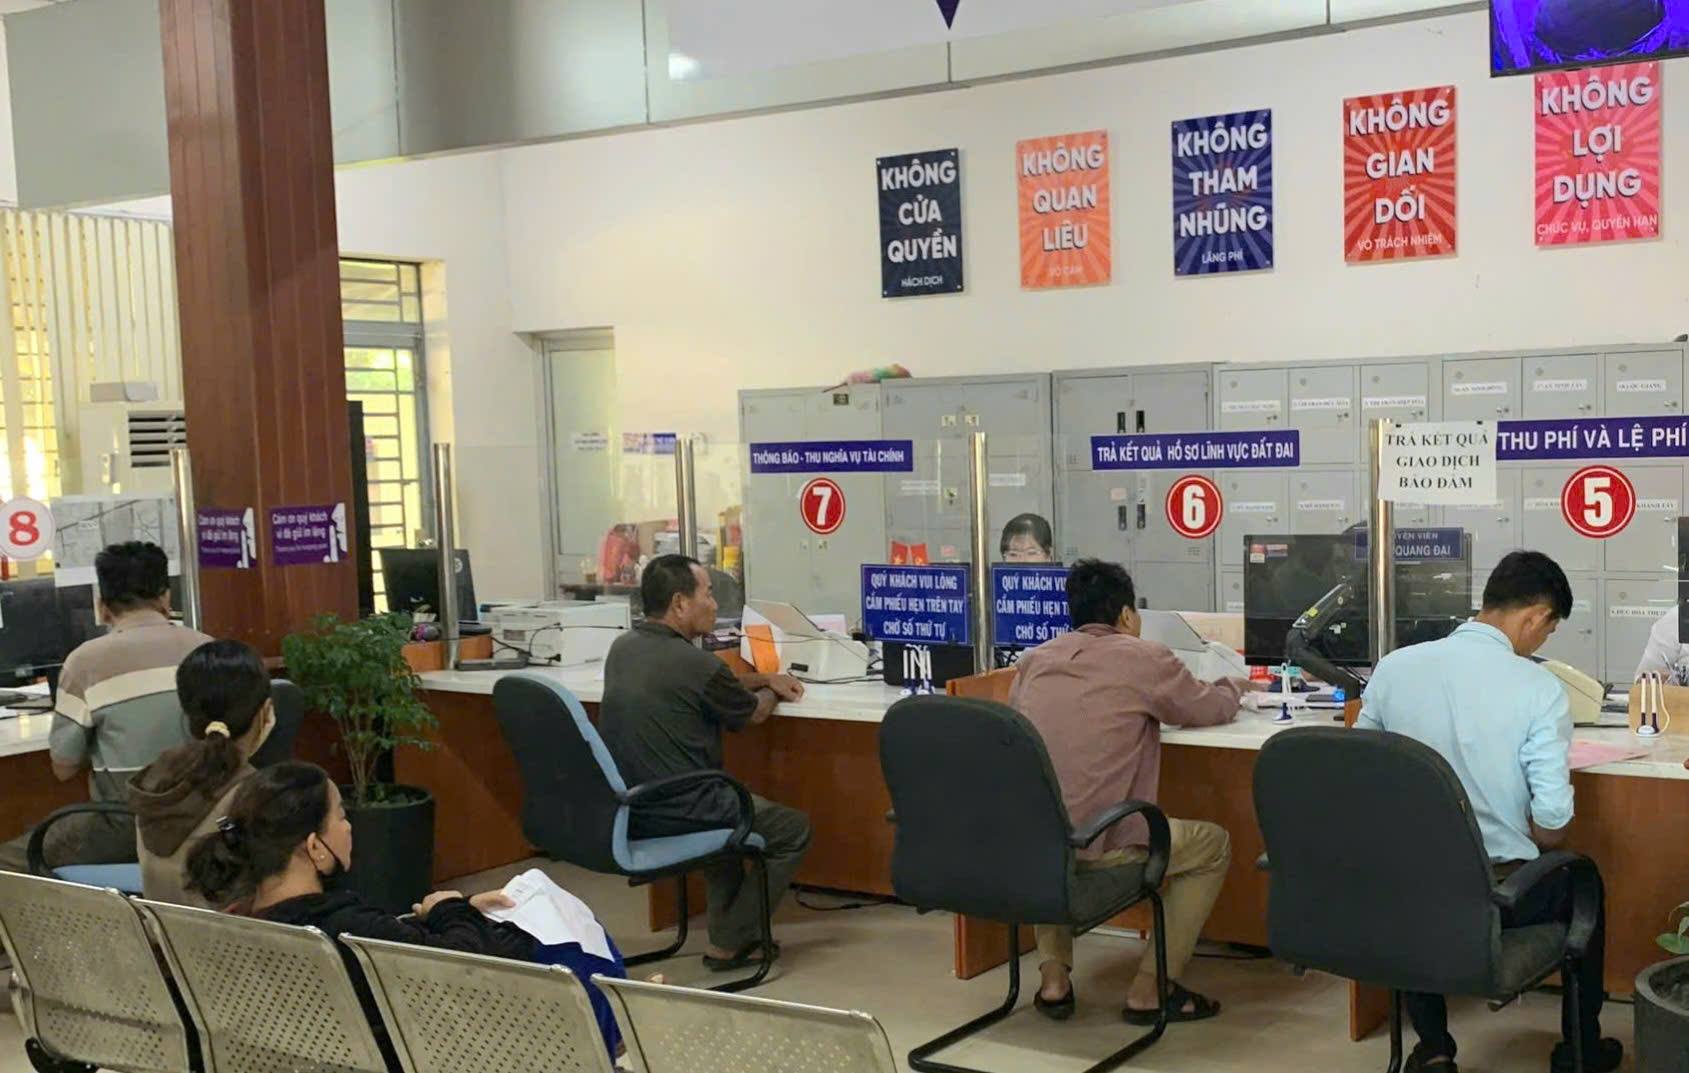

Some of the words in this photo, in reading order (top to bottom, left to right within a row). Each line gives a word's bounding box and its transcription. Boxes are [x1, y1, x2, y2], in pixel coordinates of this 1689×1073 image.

[1541, 75, 1653, 116] KHÔNG
[1350, 97, 1450, 136] KHÔNG
[1177, 121, 1267, 157] KHÔNG
[1573, 124, 1622, 163] LỢI
[881, 158, 957, 191] KHÔNG
[1023, 142, 1104, 177] KHÔNG
[1366, 148, 1434, 179] GIAN
[1188, 165, 1258, 196] THAM
[1553, 168, 1641, 208] DỤNG
[898, 194, 942, 225] CỬA
[1032, 184, 1097, 213] QUAN
[1375, 185, 1425, 224] DỐI
[1042, 219, 1088, 251] LIÊU
[1180, 203, 1268, 237] NHŨNG
[887, 227, 957, 263] QUYỀN
[1228, 247, 1244, 261] PHÍ
[1098, 440, 1117, 462] TRẢ
[1120, 440, 1139, 461] KẾT
[1141, 440, 1162, 461] QUẢ
[1185, 442, 1199, 460] SƠ
[1201, 440, 1225, 460] LĨNH
[1226, 441, 1249, 462] VỰC
[1251, 436, 1272, 459] ĐẤT
[1275, 441, 1294, 458] ĐAI
[1422, 431, 1452, 446] KẾT
[1456, 428, 1488, 448] QUẢ
[1498, 431, 1538, 450] THU
[1544, 425, 1579, 449] PHÍ
[1583, 424, 1611, 448] VÀ
[1618, 423, 1644, 452] LỆ
[1652, 422, 1688, 447] PHÍ
[753, 450, 780, 464] THÔNG
[782, 449, 799, 464] BÁO
[805, 452, 820, 463] THU
[823, 448, 848, 463] NGHĨA
[850, 451, 861, 464] VỤ
[863, 448, 876, 463] TÀI
[878, 448, 904, 463] CHÍNH
[1396, 455, 1437, 467] GIAO
[1442, 454, 1480, 470] DỊCH
[812, 486, 832, 526] 7
[1182, 484, 1206, 530] 6
[1583, 476, 1613, 527] 5
[9, 511, 40, 546] 8
[1395, 545, 1431, 556] QUANG
[871, 570, 887, 589] QUÝ
[889, 571, 918, 589] KHÁCH
[919, 574, 933, 589] VUI
[934, 572, 958, 590] LÒNG
[1002, 573, 1019, 592] QUÝ
[1022, 573, 1052, 591] KHÁCH
[1054, 576, 1067, 592] VU
[884, 592, 907, 612] PHIẾU
[926, 595, 947, 613] TRÊN
[948, 599, 964, 614] TAY
[1016, 595, 1040, 615] PHIẾU
[1043, 601, 1060, 618] HẸN
[902, 617, 915, 636] SỐ
[934, 621, 946, 640] TỰ
[1036, 621, 1049, 640] SỐ
